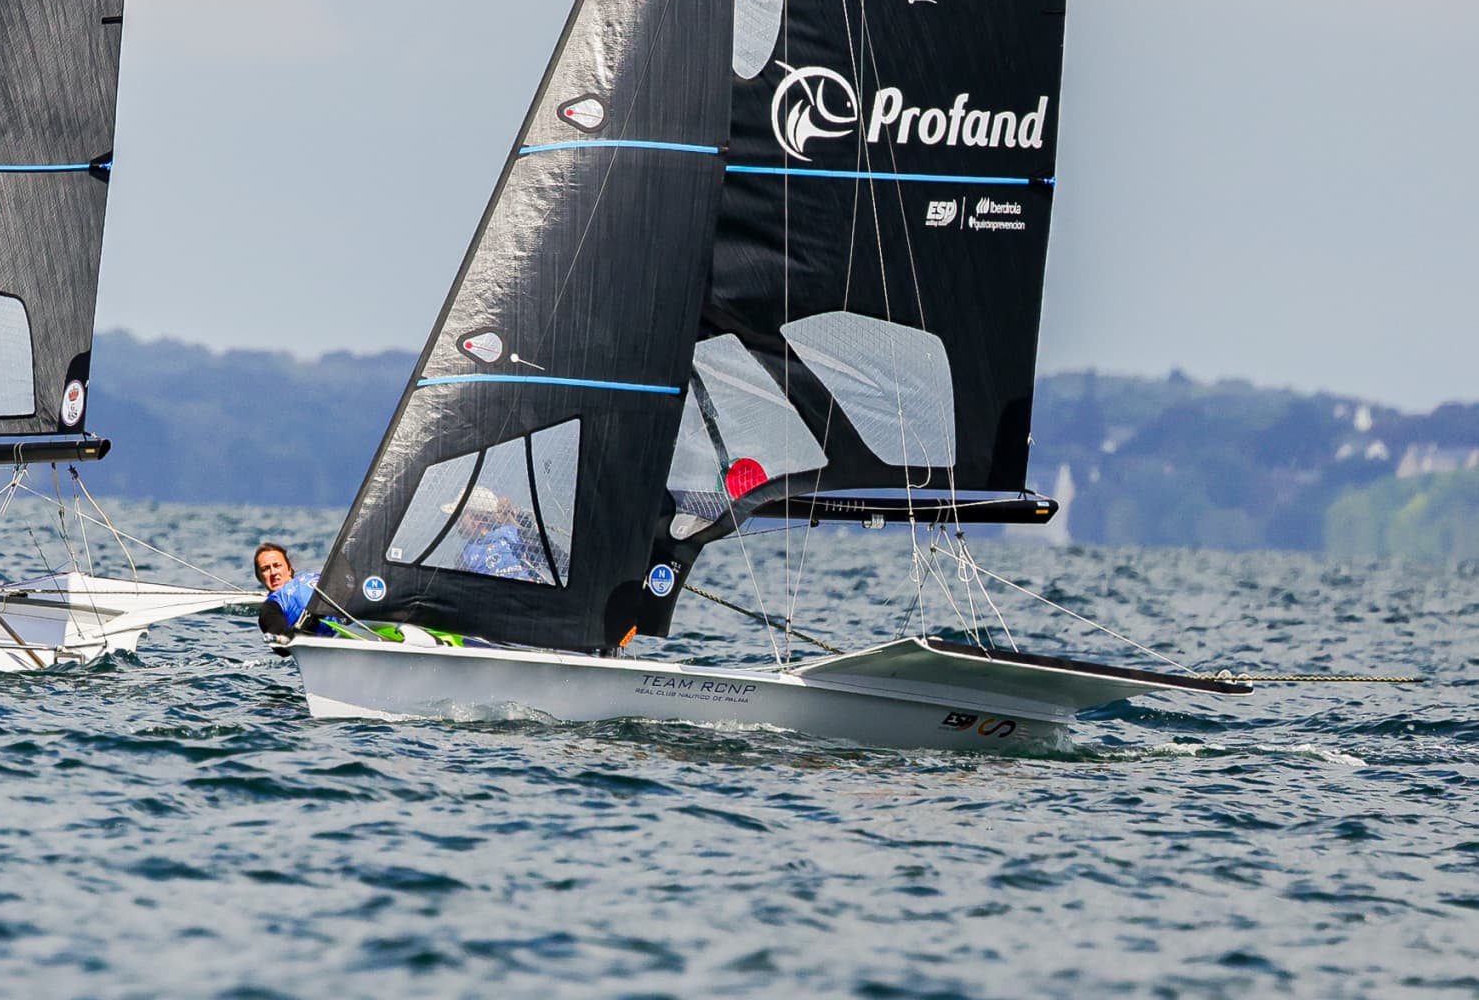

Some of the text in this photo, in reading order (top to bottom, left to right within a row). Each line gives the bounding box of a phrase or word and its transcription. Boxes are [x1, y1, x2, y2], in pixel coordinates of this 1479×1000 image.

[866, 86, 1049, 150] Profand
[658, 569, 666, 579] N
[658, 582, 665, 591] S
[643, 674, 757, 696] TEAM RCNP
